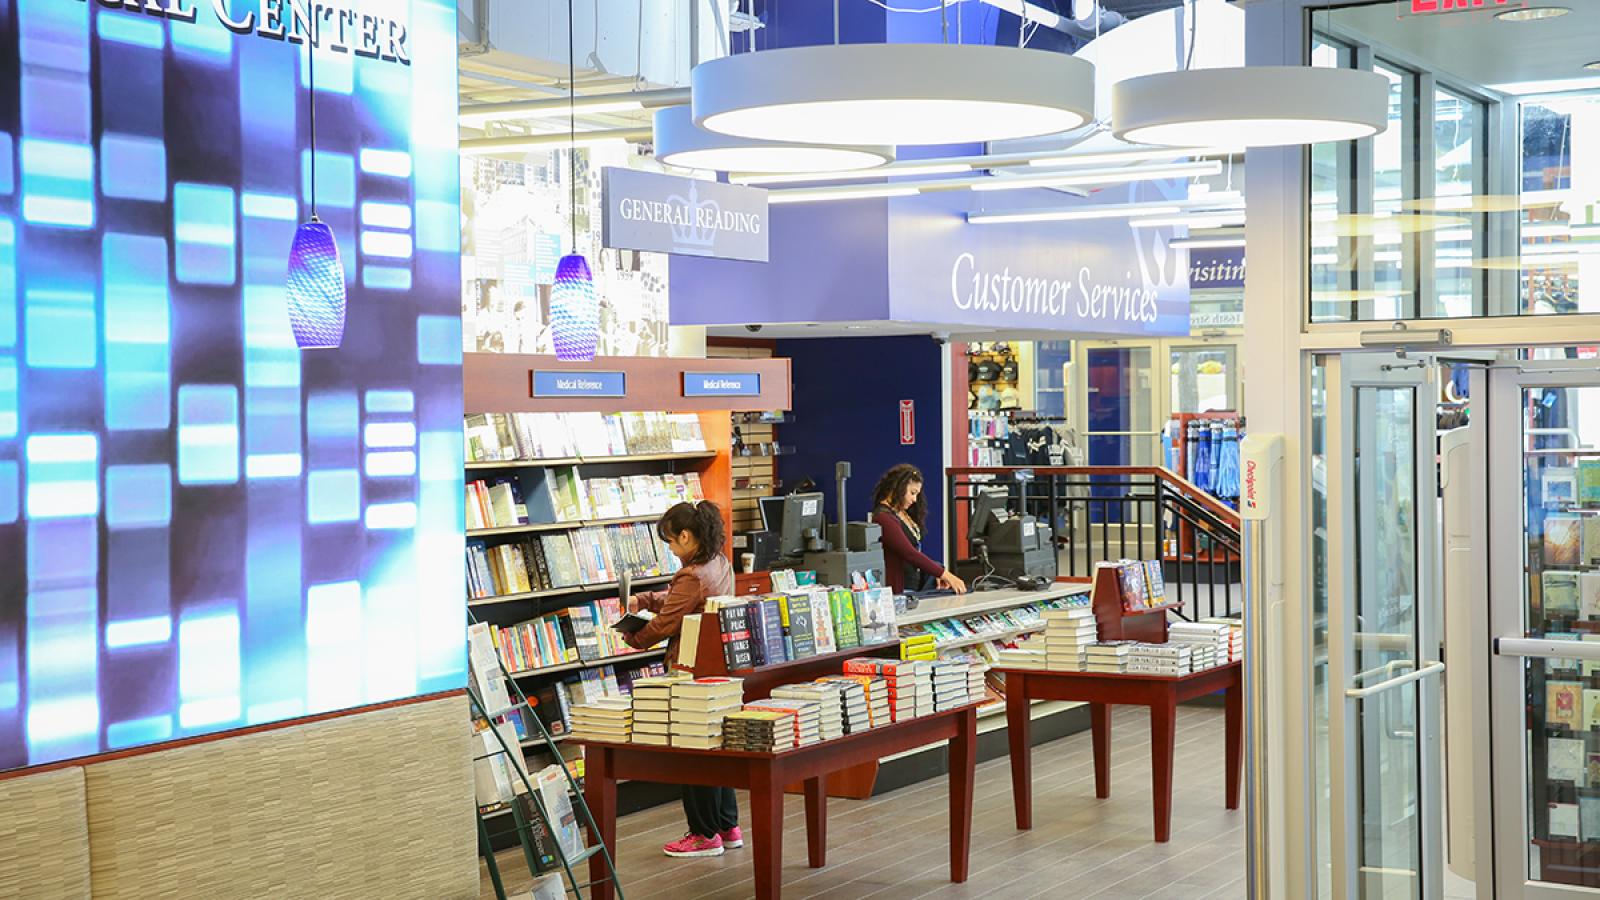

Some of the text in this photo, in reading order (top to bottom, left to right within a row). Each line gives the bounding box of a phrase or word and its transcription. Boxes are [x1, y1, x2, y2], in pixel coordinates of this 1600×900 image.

[620, 198, 760, 234] GENERAL READING
[951, 252, 1159, 323] Customer Services
[556, 379, 577, 390] Medical
